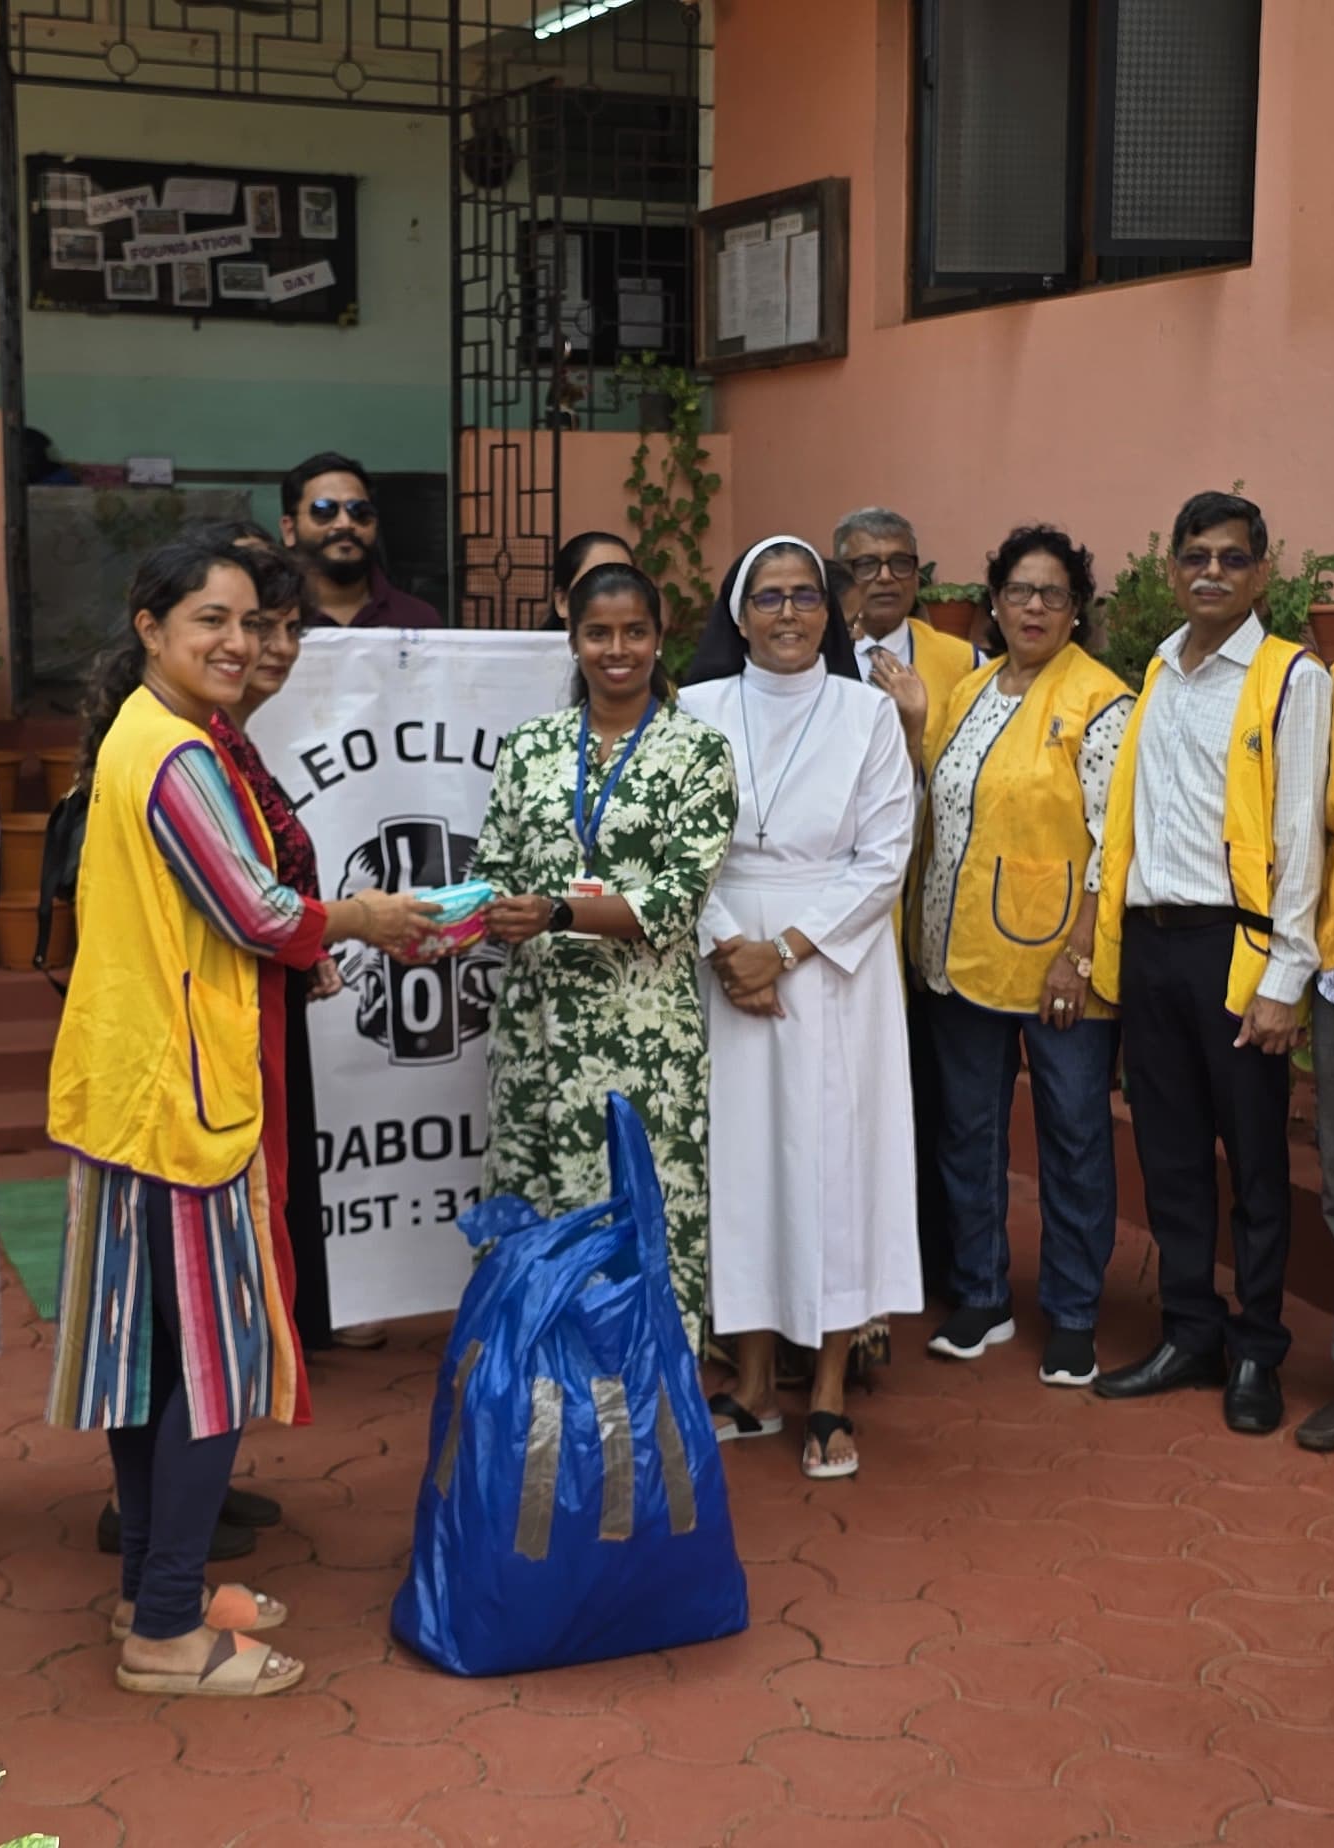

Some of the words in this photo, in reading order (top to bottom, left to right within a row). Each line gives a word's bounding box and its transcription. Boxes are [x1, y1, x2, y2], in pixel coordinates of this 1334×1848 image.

[130, 233, 243, 260] FOUNDATION
[282, 272, 316, 292] DAY
[395, 721, 505, 772] CLU
[433, 1187, 481, 1214] 31
